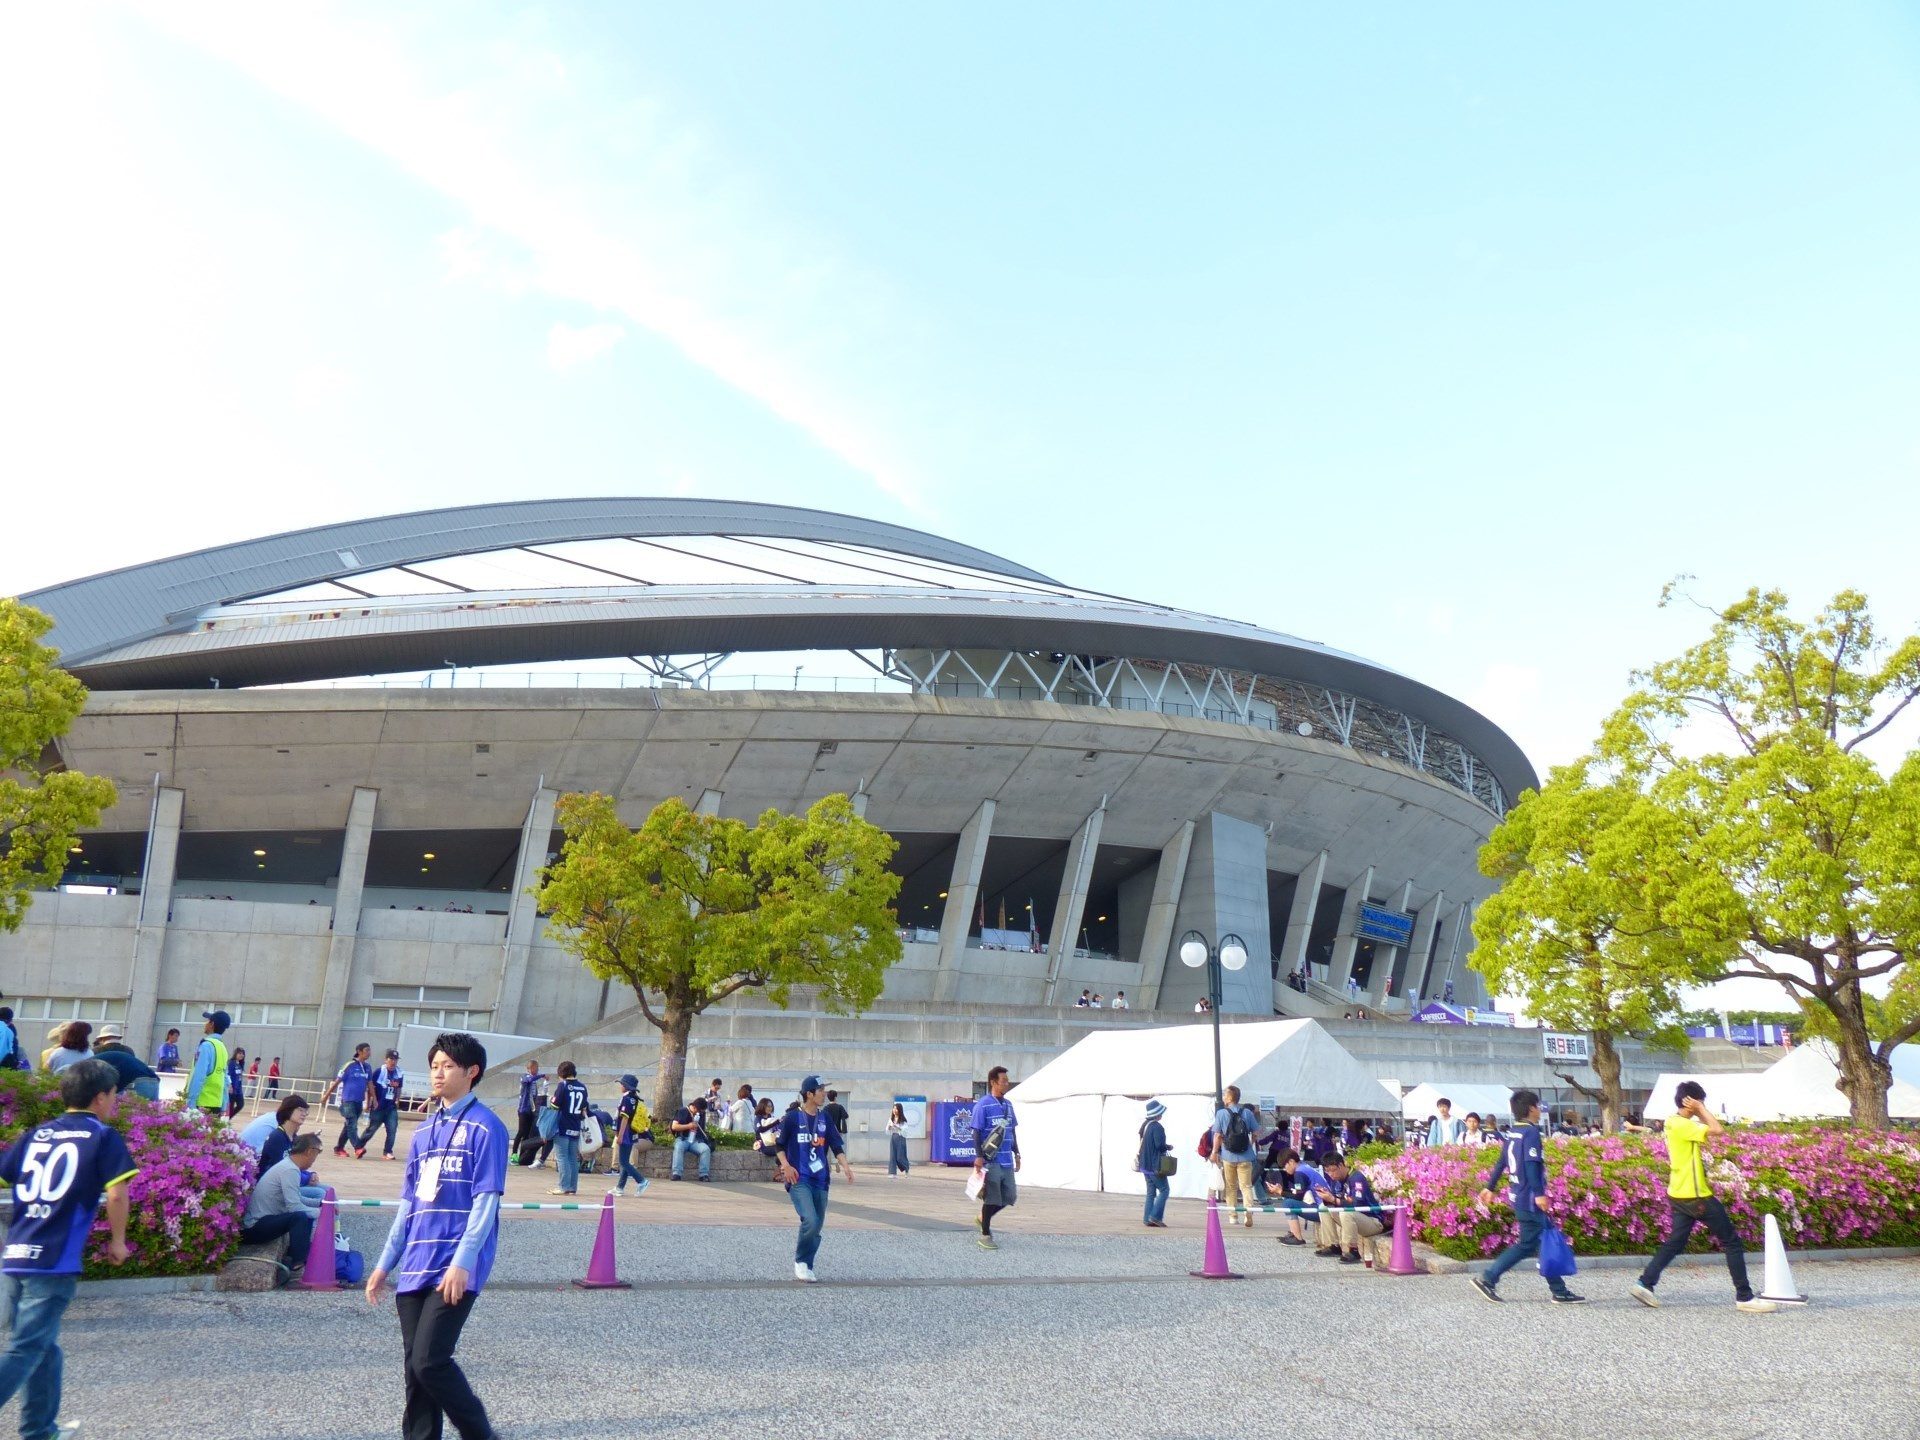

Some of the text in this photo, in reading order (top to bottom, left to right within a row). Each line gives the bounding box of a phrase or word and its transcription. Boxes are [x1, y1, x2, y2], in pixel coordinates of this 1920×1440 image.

[1420, 1012, 1447, 1022] SANFRECCE
[1546, 1037, 1587, 1055] 朝日新聞
[569, 1091, 584, 1114] 12
[16, 1142, 79, 1202] 50
